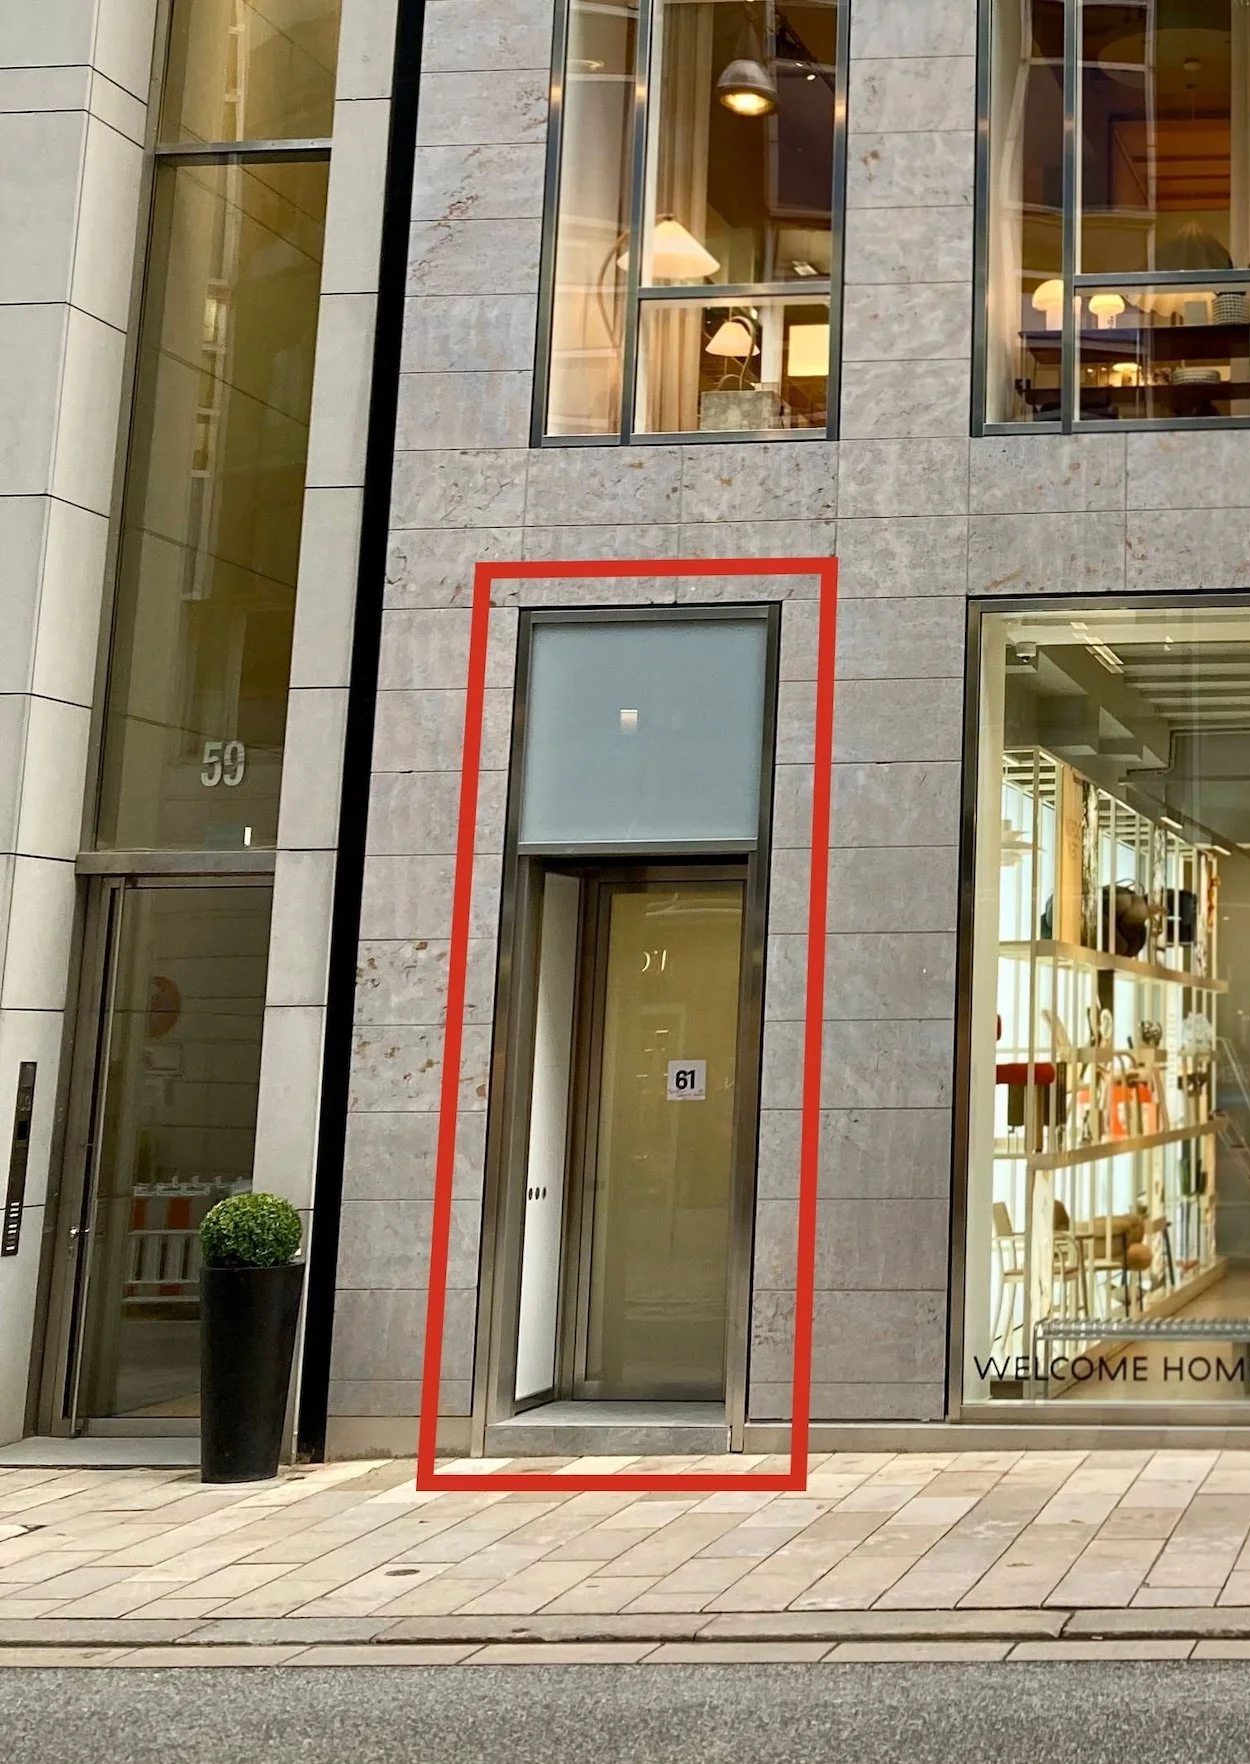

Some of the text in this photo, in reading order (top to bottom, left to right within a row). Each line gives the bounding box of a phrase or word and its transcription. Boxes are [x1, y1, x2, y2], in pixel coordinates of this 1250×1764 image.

[201, 741, 245, 787] 59
[675, 1069, 696, 1090] 61
[973, 1355, 1148, 1382] WELCOME
